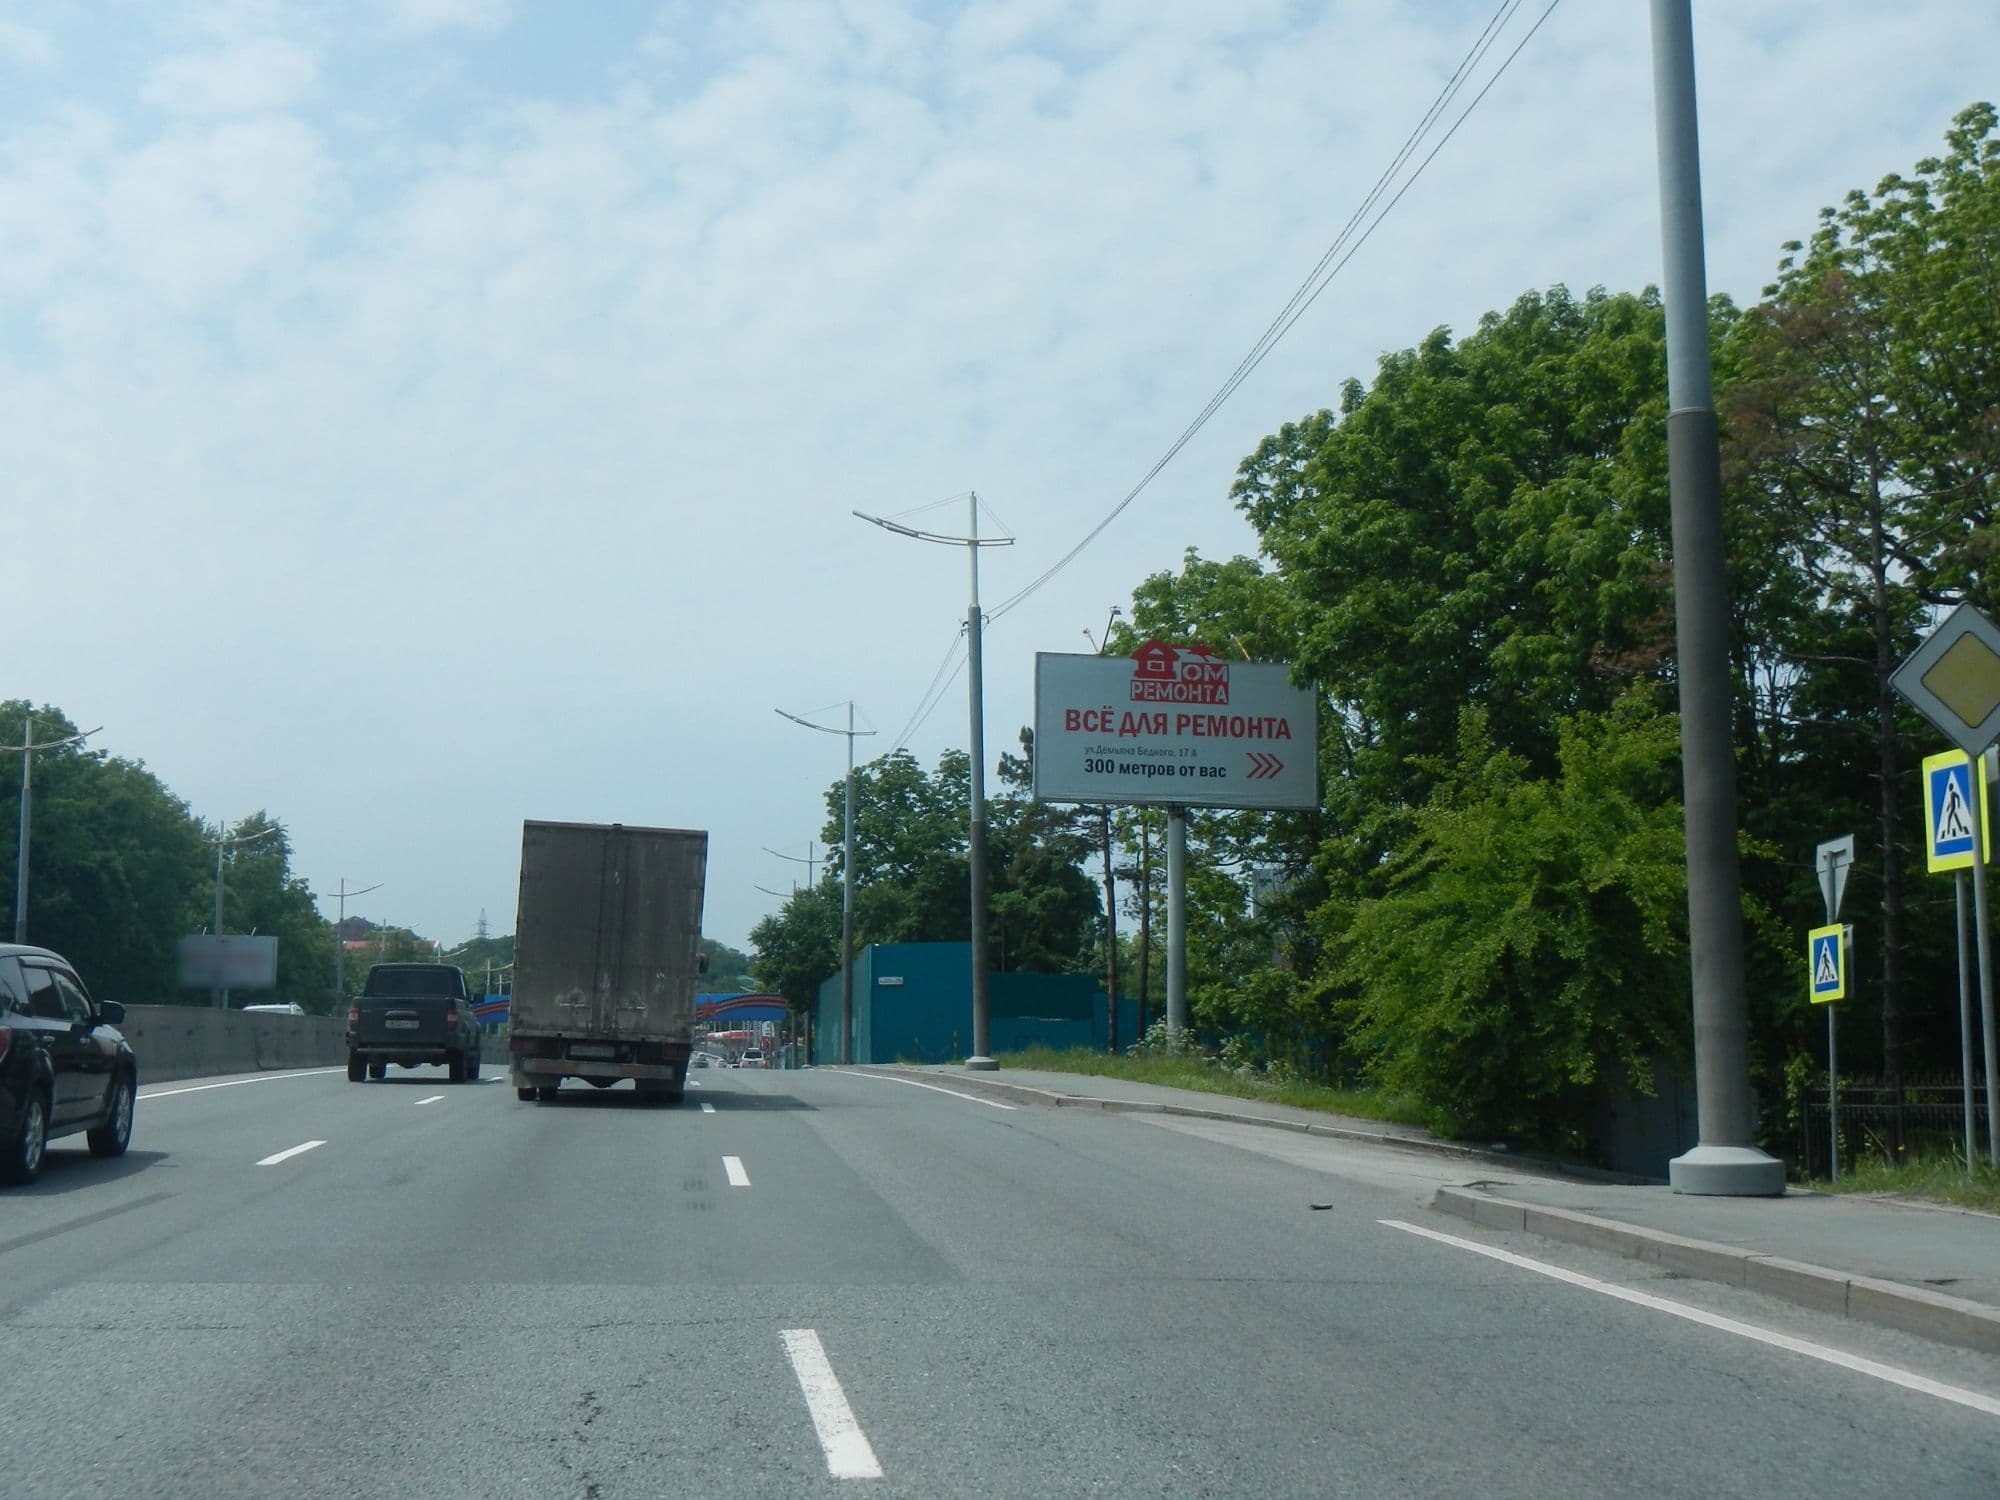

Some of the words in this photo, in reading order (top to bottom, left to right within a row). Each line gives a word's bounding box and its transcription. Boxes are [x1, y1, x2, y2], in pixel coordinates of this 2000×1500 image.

[1131, 681, 1228, 704] РЕМОНТА
[1065, 705, 1115, 733] ВСЁ
[1119, 711, 1168, 738] ДЛЯ
[1176, 713, 1292, 740] РЕМОНТА
[1085, 758, 1114, 774] 300
[1119, 763, 1175, 779] метров
[1179, 765, 1195, 777] от
[1199, 766, 1226, 778] вас
